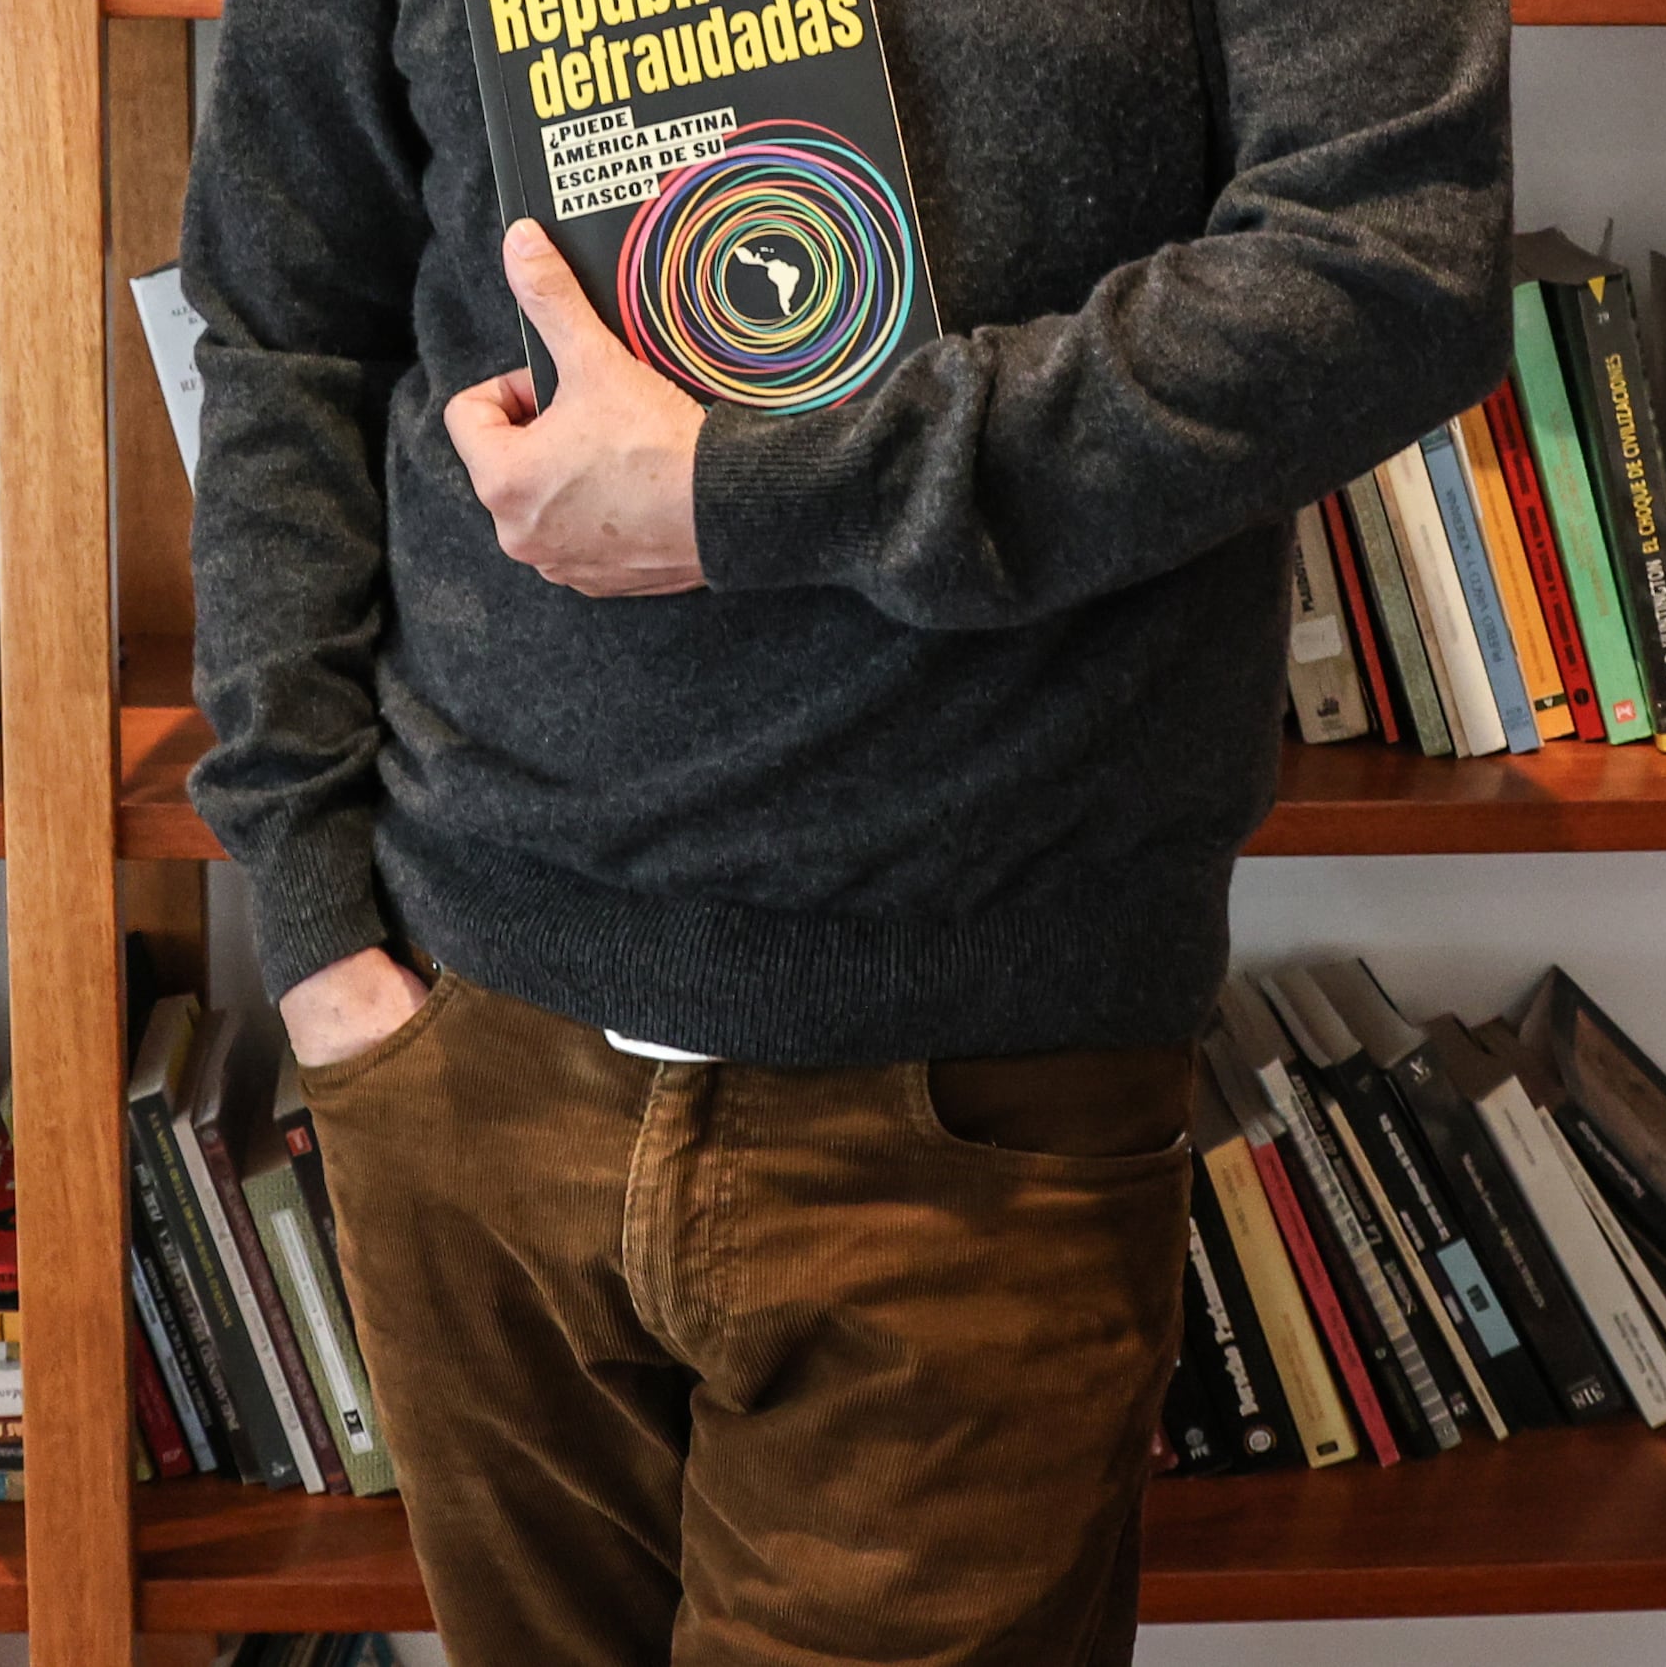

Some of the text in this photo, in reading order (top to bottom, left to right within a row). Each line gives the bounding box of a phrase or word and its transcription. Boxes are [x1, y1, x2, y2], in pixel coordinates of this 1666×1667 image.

[549, 111, 630, 149] ¿PUEDE
[552, 110, 735, 167] AMÉRICA LATINA
[556, 138, 724, 191] ESCAPAR DE SU
[560, 179, 656, 214] ATASCO?
[1604, 352, 1659, 554] EL CHOQUE DE CIVILIZACIONES
